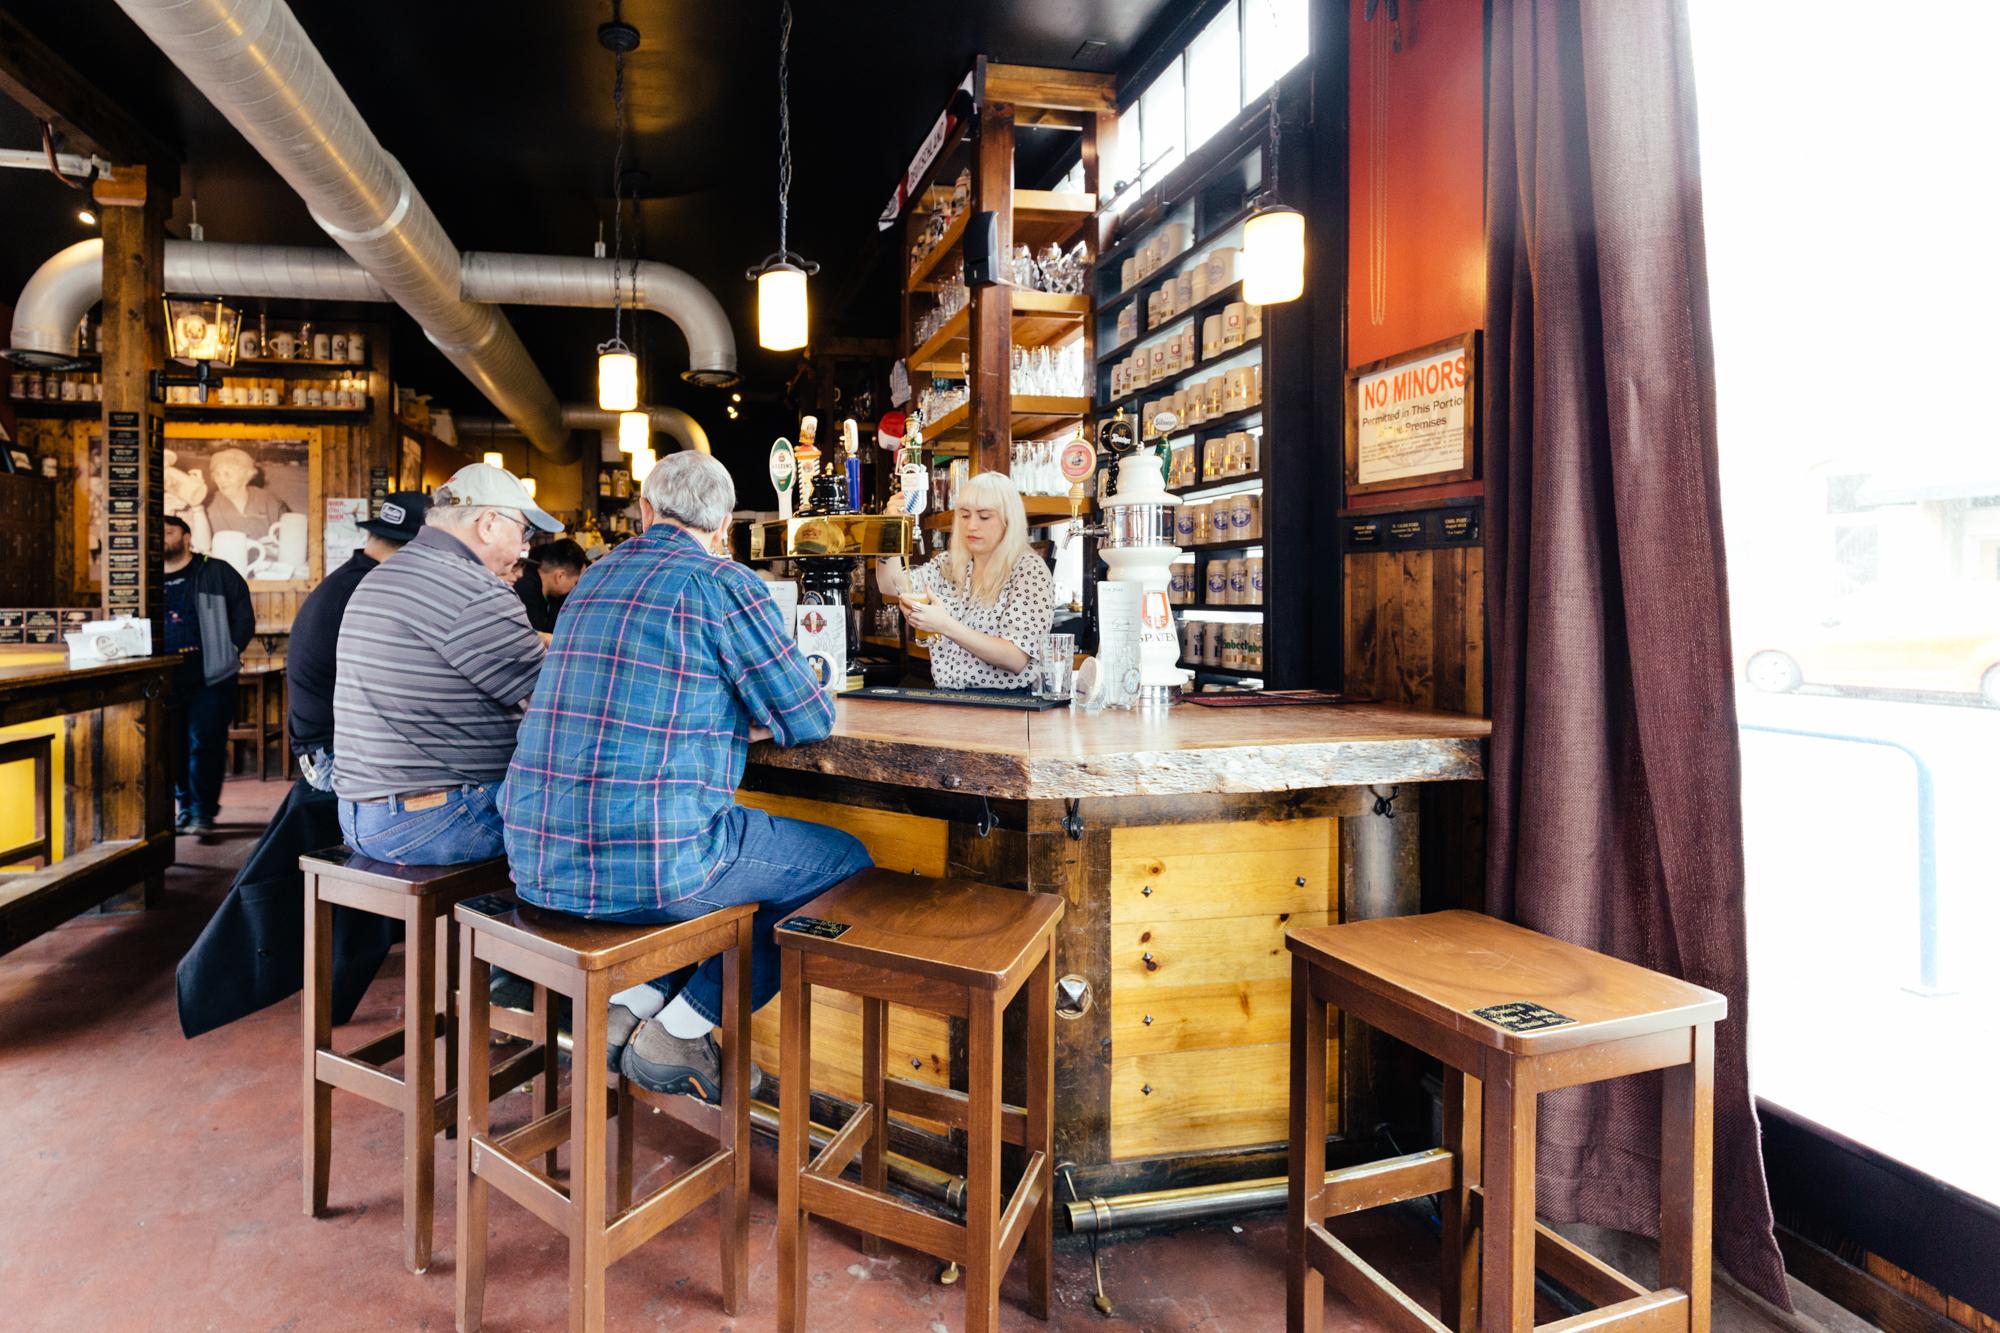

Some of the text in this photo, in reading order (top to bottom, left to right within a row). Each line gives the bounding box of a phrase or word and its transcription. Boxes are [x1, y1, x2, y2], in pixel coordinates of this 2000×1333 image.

[1364, 355, 1465, 411] NO MINORS
[1362, 408, 1400, 427] Permitted
[1401, 409, 1410, 419] in
[1412, 402, 1431, 416] This
[1405, 416, 1448, 432] Premises
